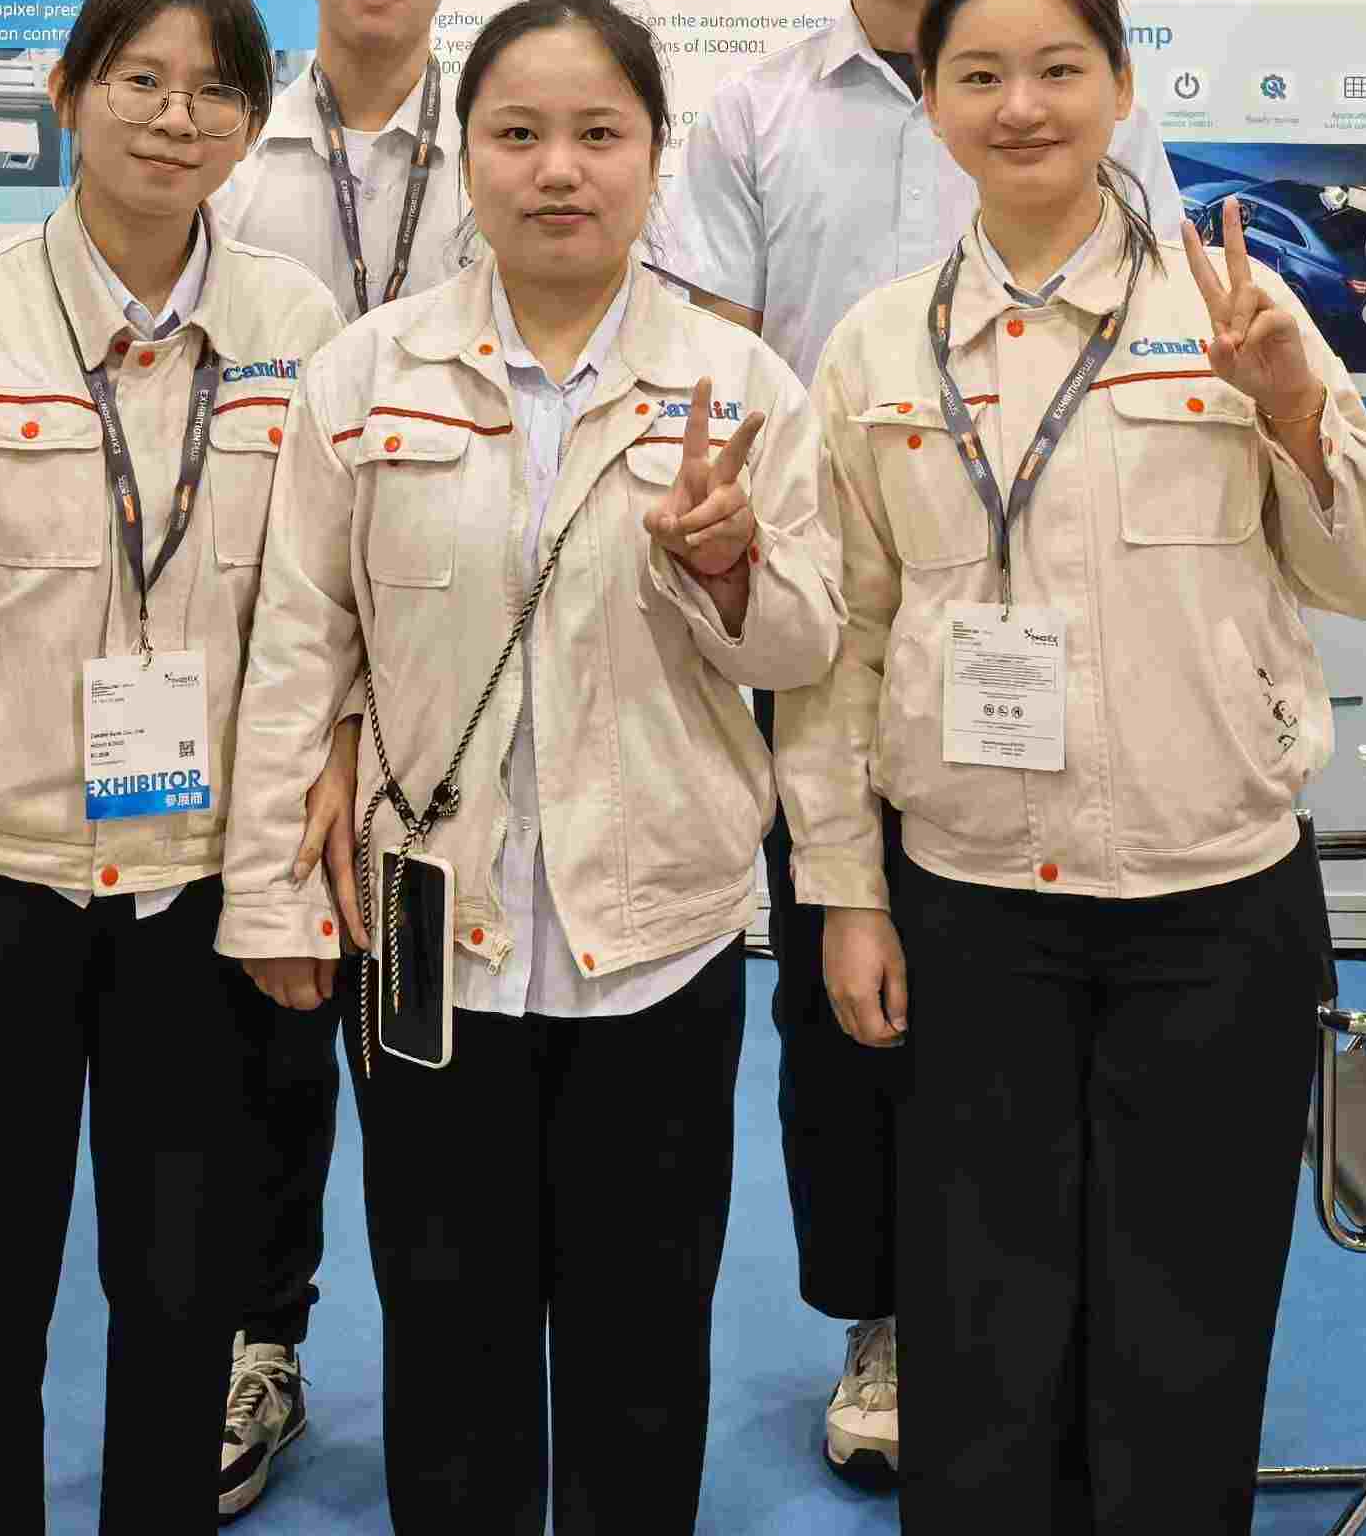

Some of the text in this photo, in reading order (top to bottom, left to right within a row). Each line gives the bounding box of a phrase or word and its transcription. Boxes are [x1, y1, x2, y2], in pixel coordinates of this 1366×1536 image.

[671, 12, 696, 28] the
[700, 13, 788, 29] automotive
[87, 769, 202, 798] EXHIBITOR
